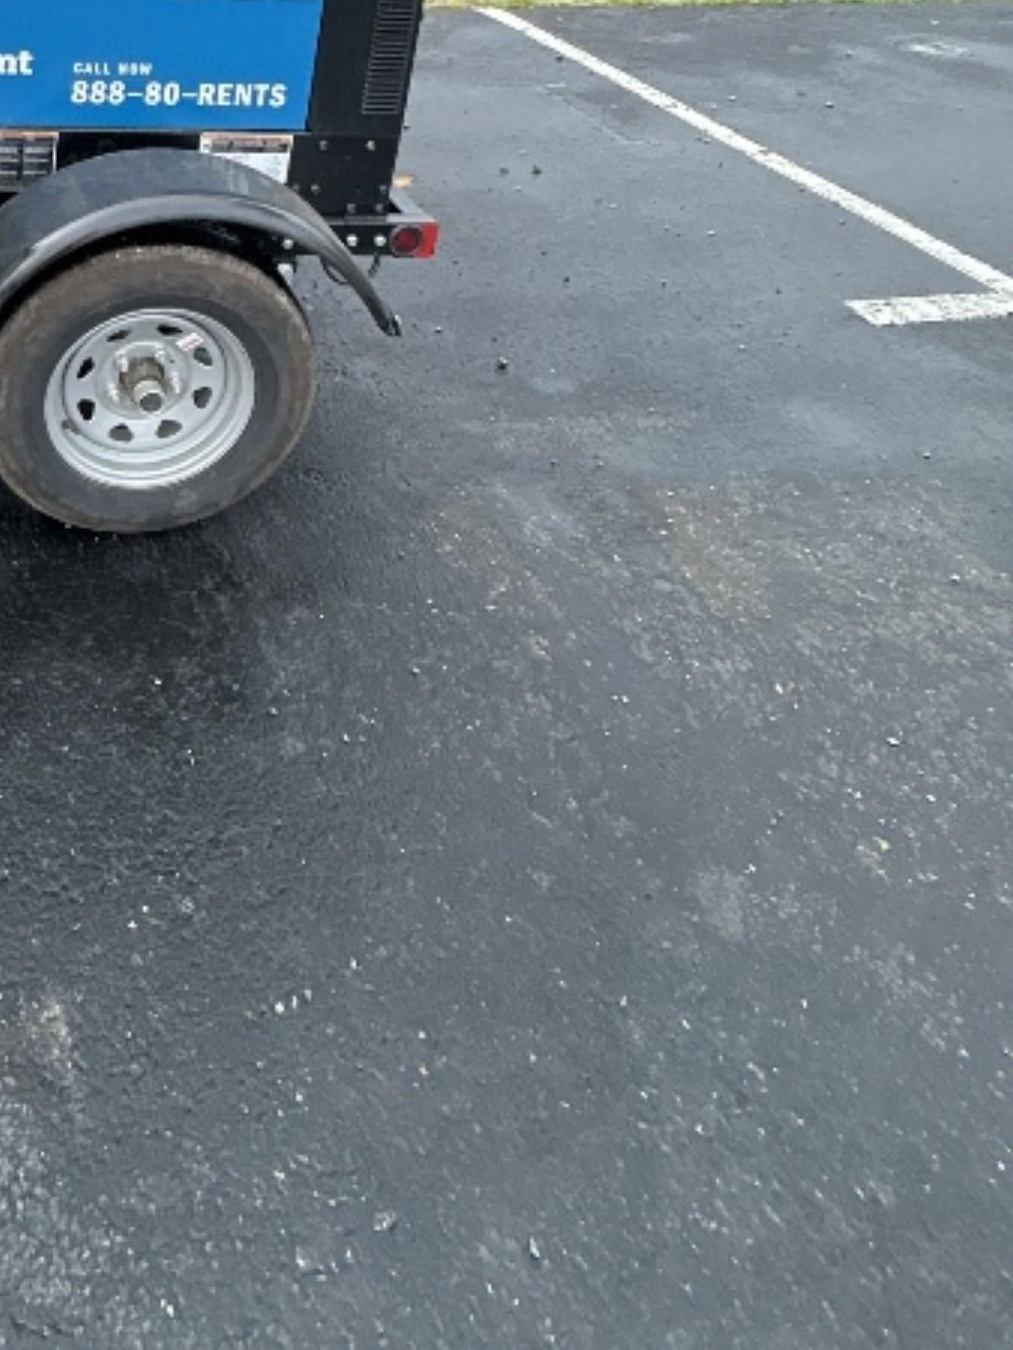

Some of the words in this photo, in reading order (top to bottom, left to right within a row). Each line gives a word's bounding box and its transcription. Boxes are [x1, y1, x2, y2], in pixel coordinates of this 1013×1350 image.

[72, 61, 111, 76] CALL
[117, 61, 154, 77] NOW
[70, 79, 287, 108] 888-80-RENTS
